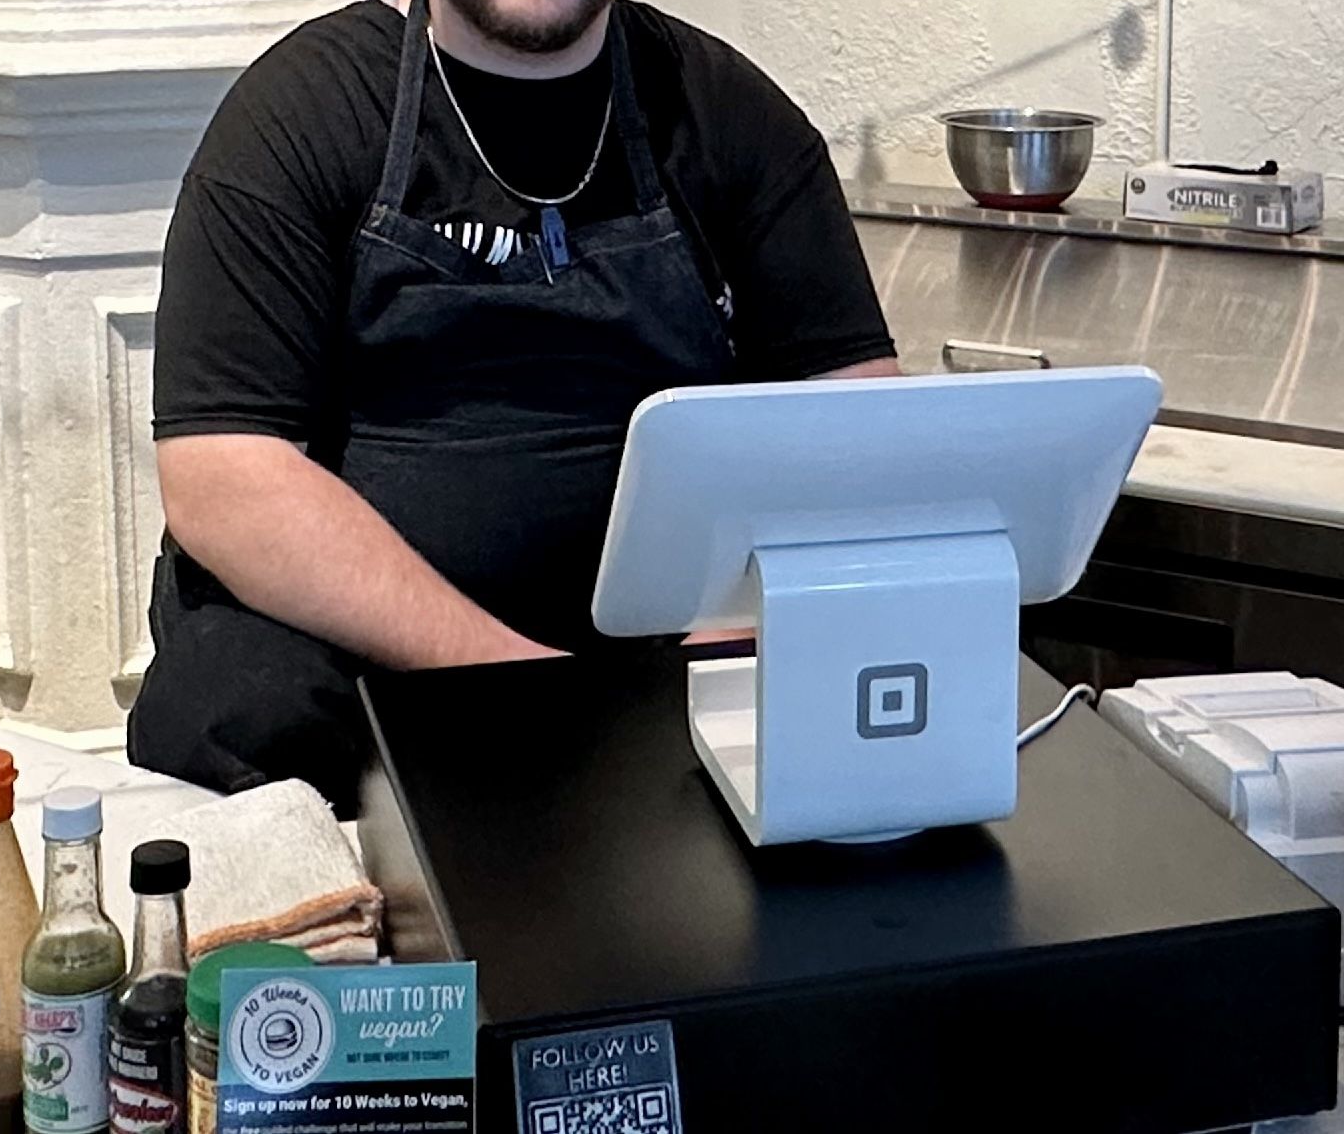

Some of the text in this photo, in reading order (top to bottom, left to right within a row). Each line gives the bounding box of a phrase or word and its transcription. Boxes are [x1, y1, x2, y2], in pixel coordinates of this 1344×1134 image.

[1172, 187, 1239, 208] NITRILE
[244, 984, 309, 1018] 10 Weeks
[340, 984, 467, 1014] WANT TO TRY
[359, 1011, 445, 1048] vegan?
[532, 1033, 660, 1071] FOLLOW US
[251, 1053, 320, 1085] TO VEGAN
[568, 1064, 628, 1093] HERE!
[223, 1091, 470, 1117] Sign up now for 10 Weeks to Vegan,
